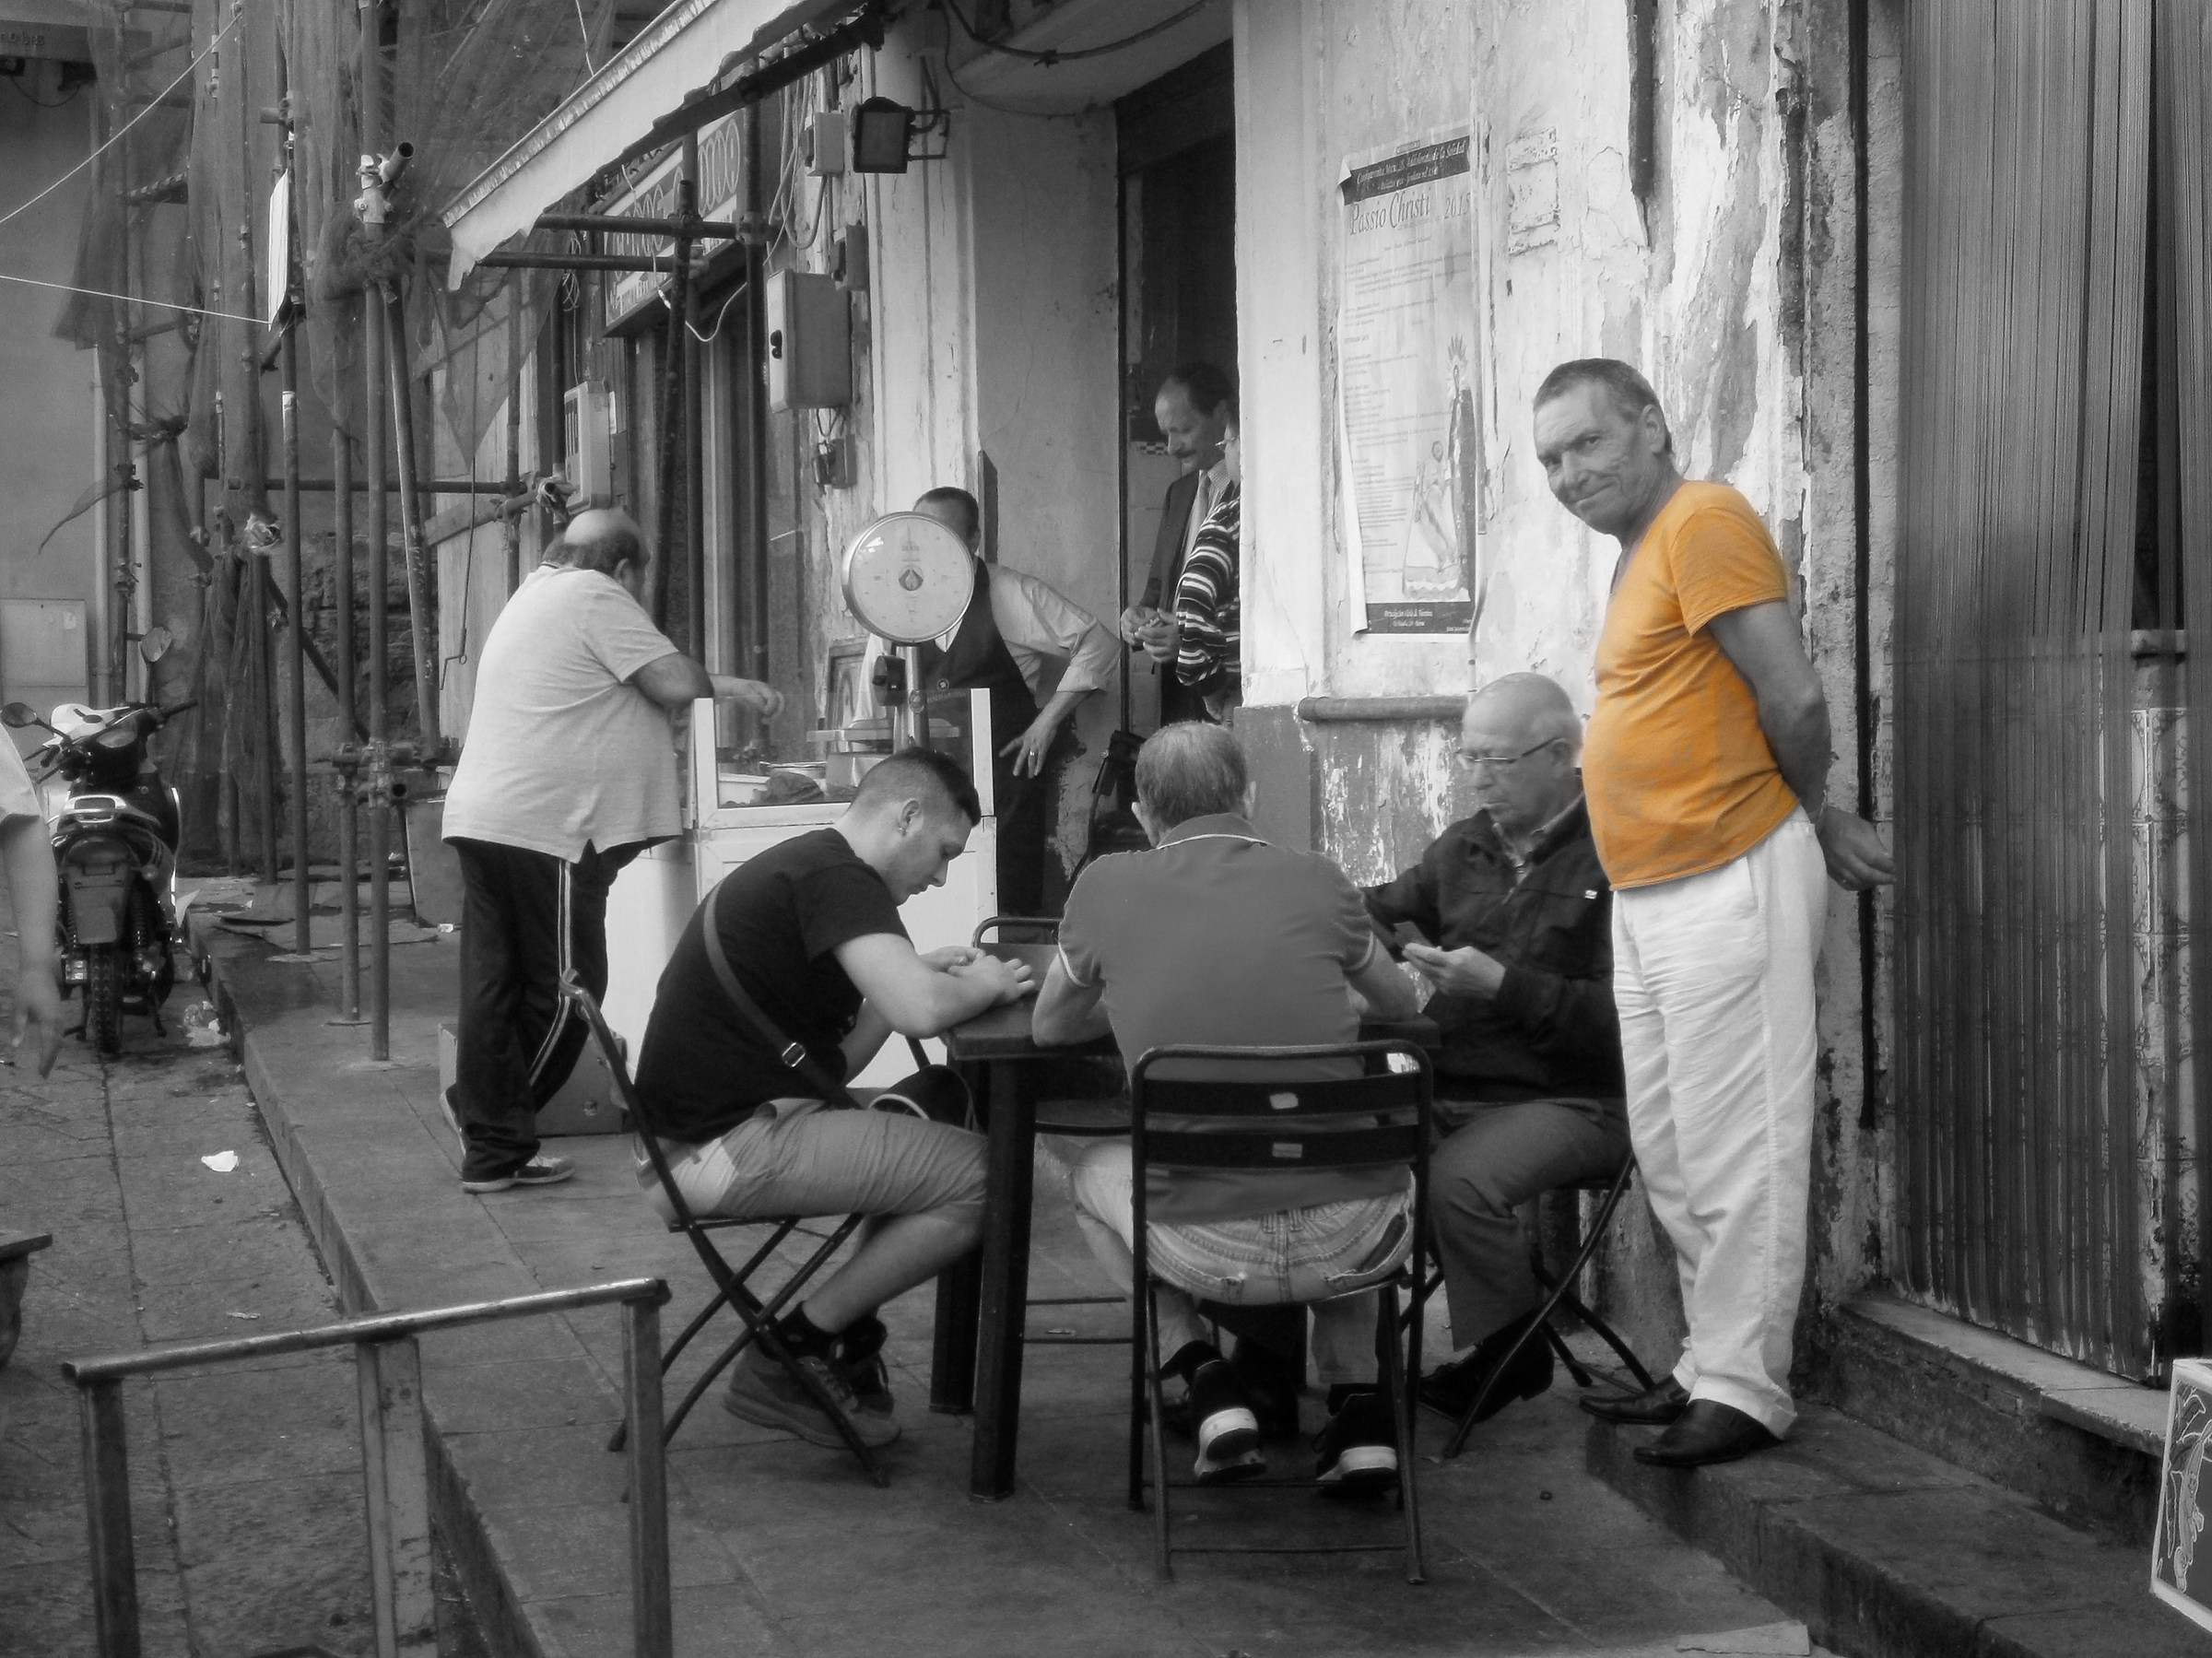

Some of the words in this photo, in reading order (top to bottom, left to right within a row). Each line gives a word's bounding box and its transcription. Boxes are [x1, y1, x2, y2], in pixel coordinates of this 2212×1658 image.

[1350, 200, 1386, 235] Passio
[1389, 186, 1431, 229] Christi
[1444, 192, 1471, 219] 2015
